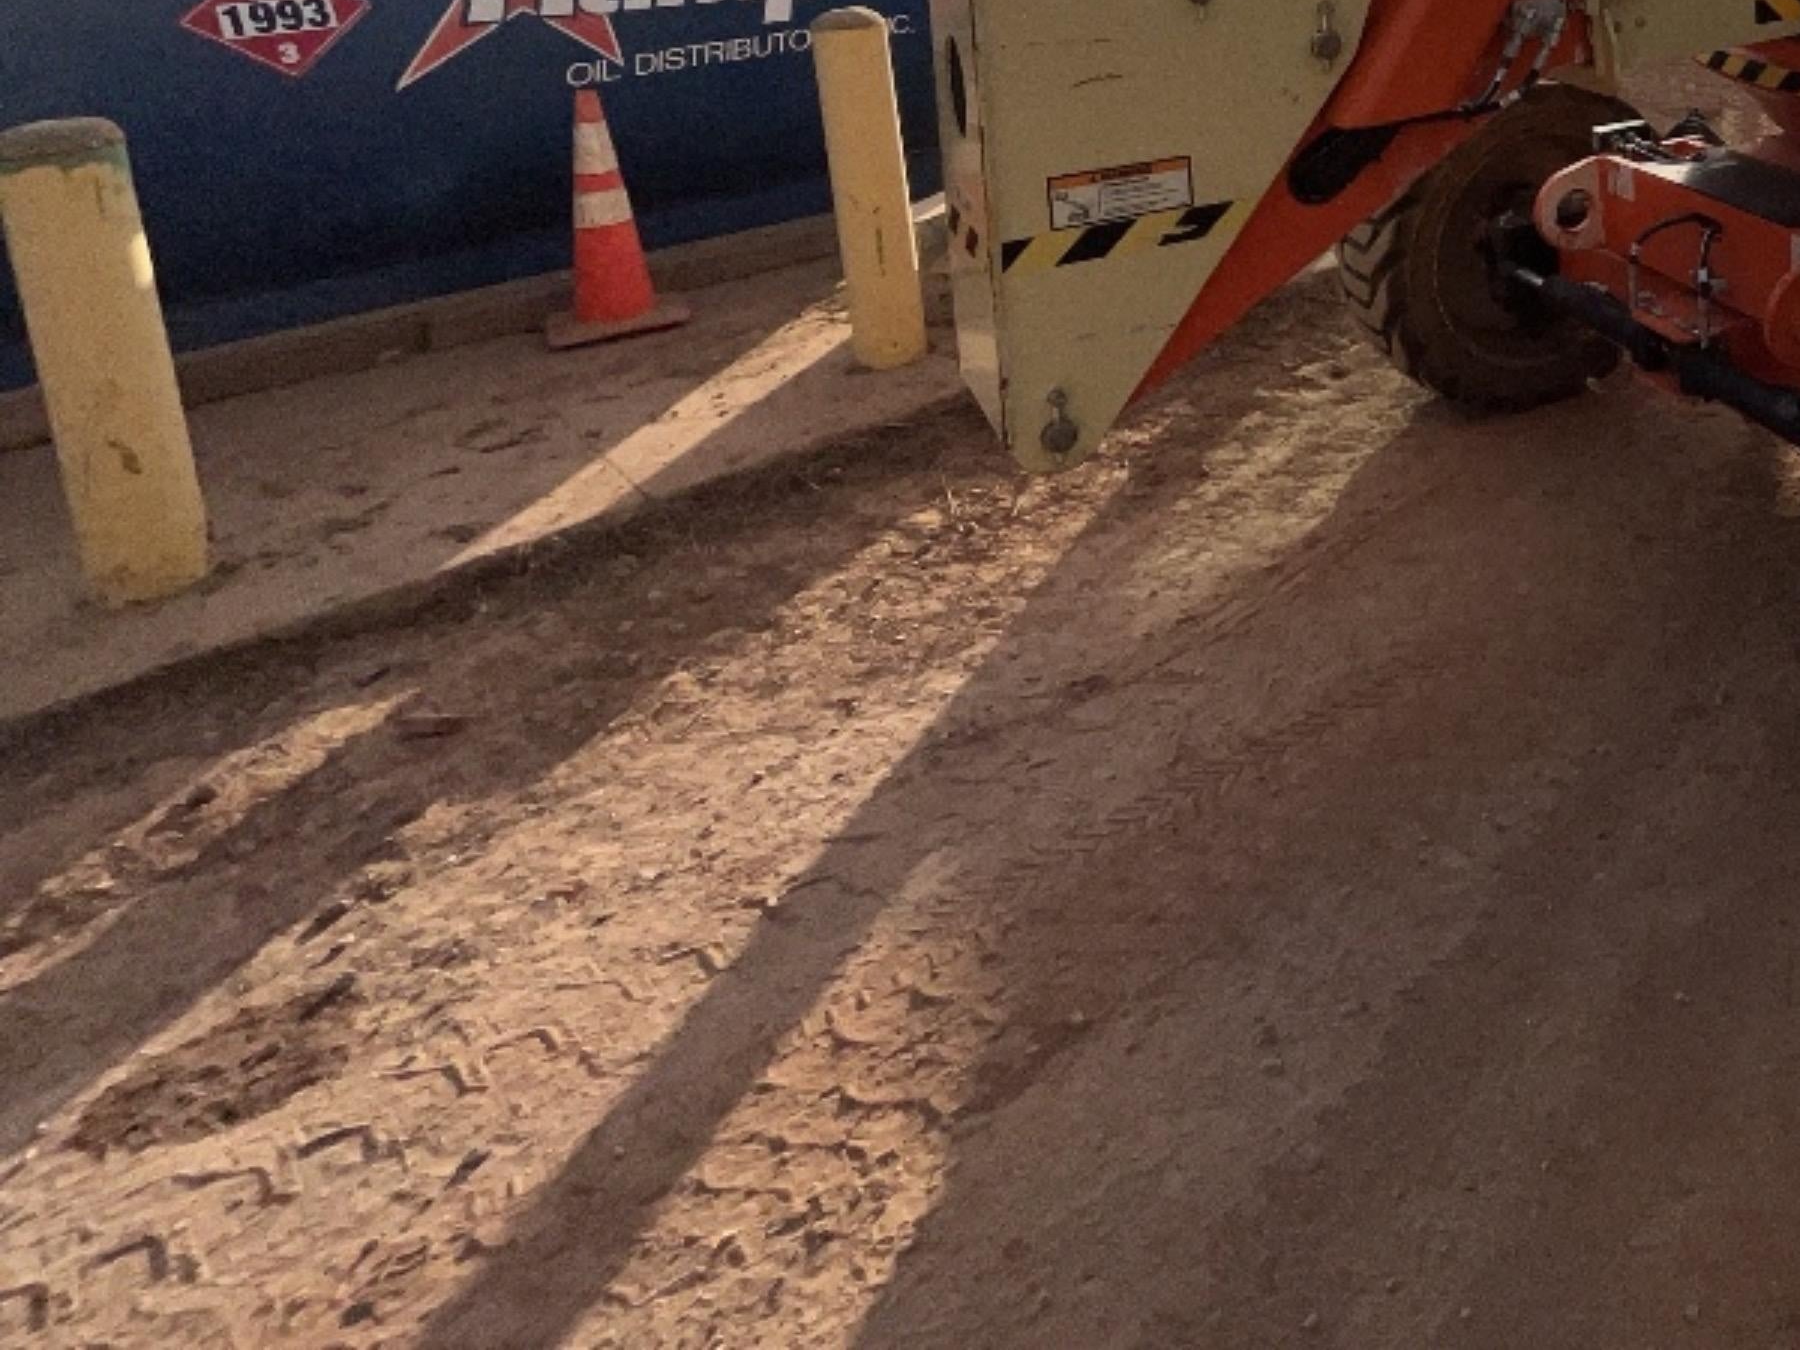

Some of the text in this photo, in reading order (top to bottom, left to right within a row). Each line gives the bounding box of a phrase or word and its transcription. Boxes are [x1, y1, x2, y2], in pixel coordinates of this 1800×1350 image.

[278, 42, 300, 64] 3
[566, 60, 622, 87] OIL
[635, 29, 812, 77] DISTRIBUTO
